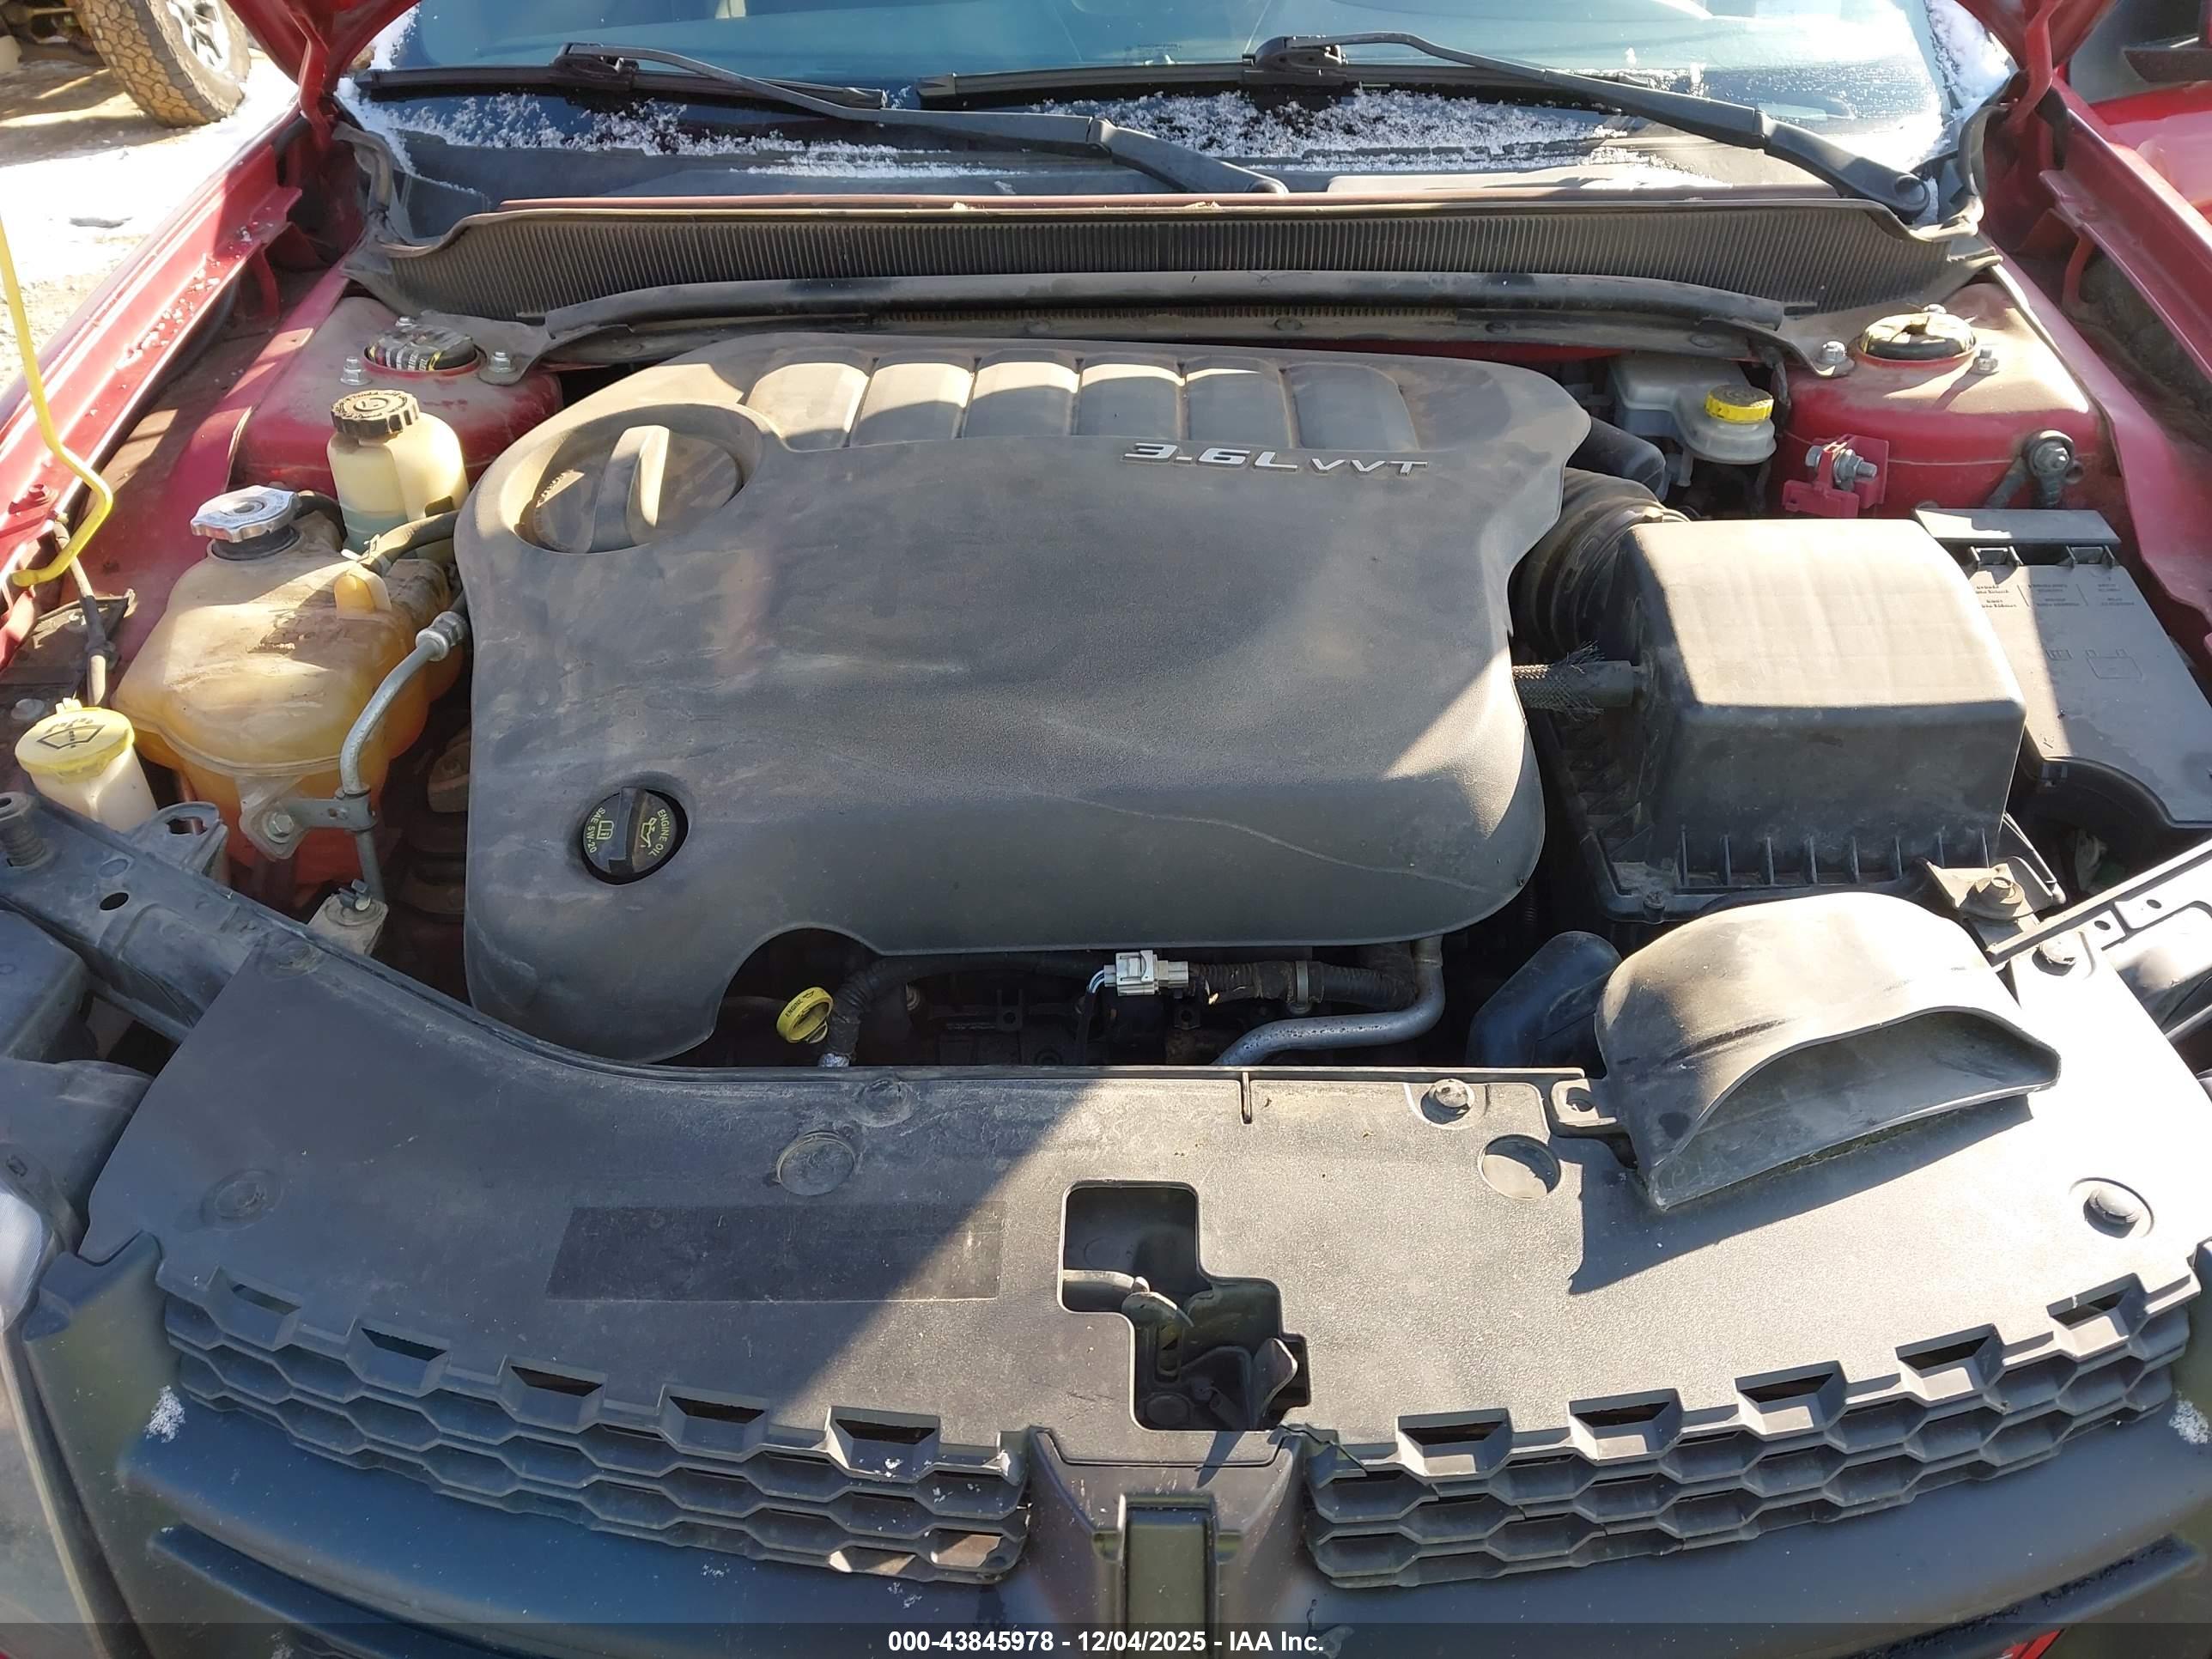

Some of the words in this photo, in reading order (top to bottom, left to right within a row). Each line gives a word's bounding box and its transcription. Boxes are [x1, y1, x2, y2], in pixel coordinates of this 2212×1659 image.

[1121, 442, 1297, 472] 3.6L
[1311, 458, 1429, 476] VVT
[591, 807, 605, 824] SAE
[657, 809, 671, 842] ENGINE
[586, 825, 598, 854] 5W-20
[647, 843, 664, 857] OIL
[785, 999, 804, 1018] ENGINE
